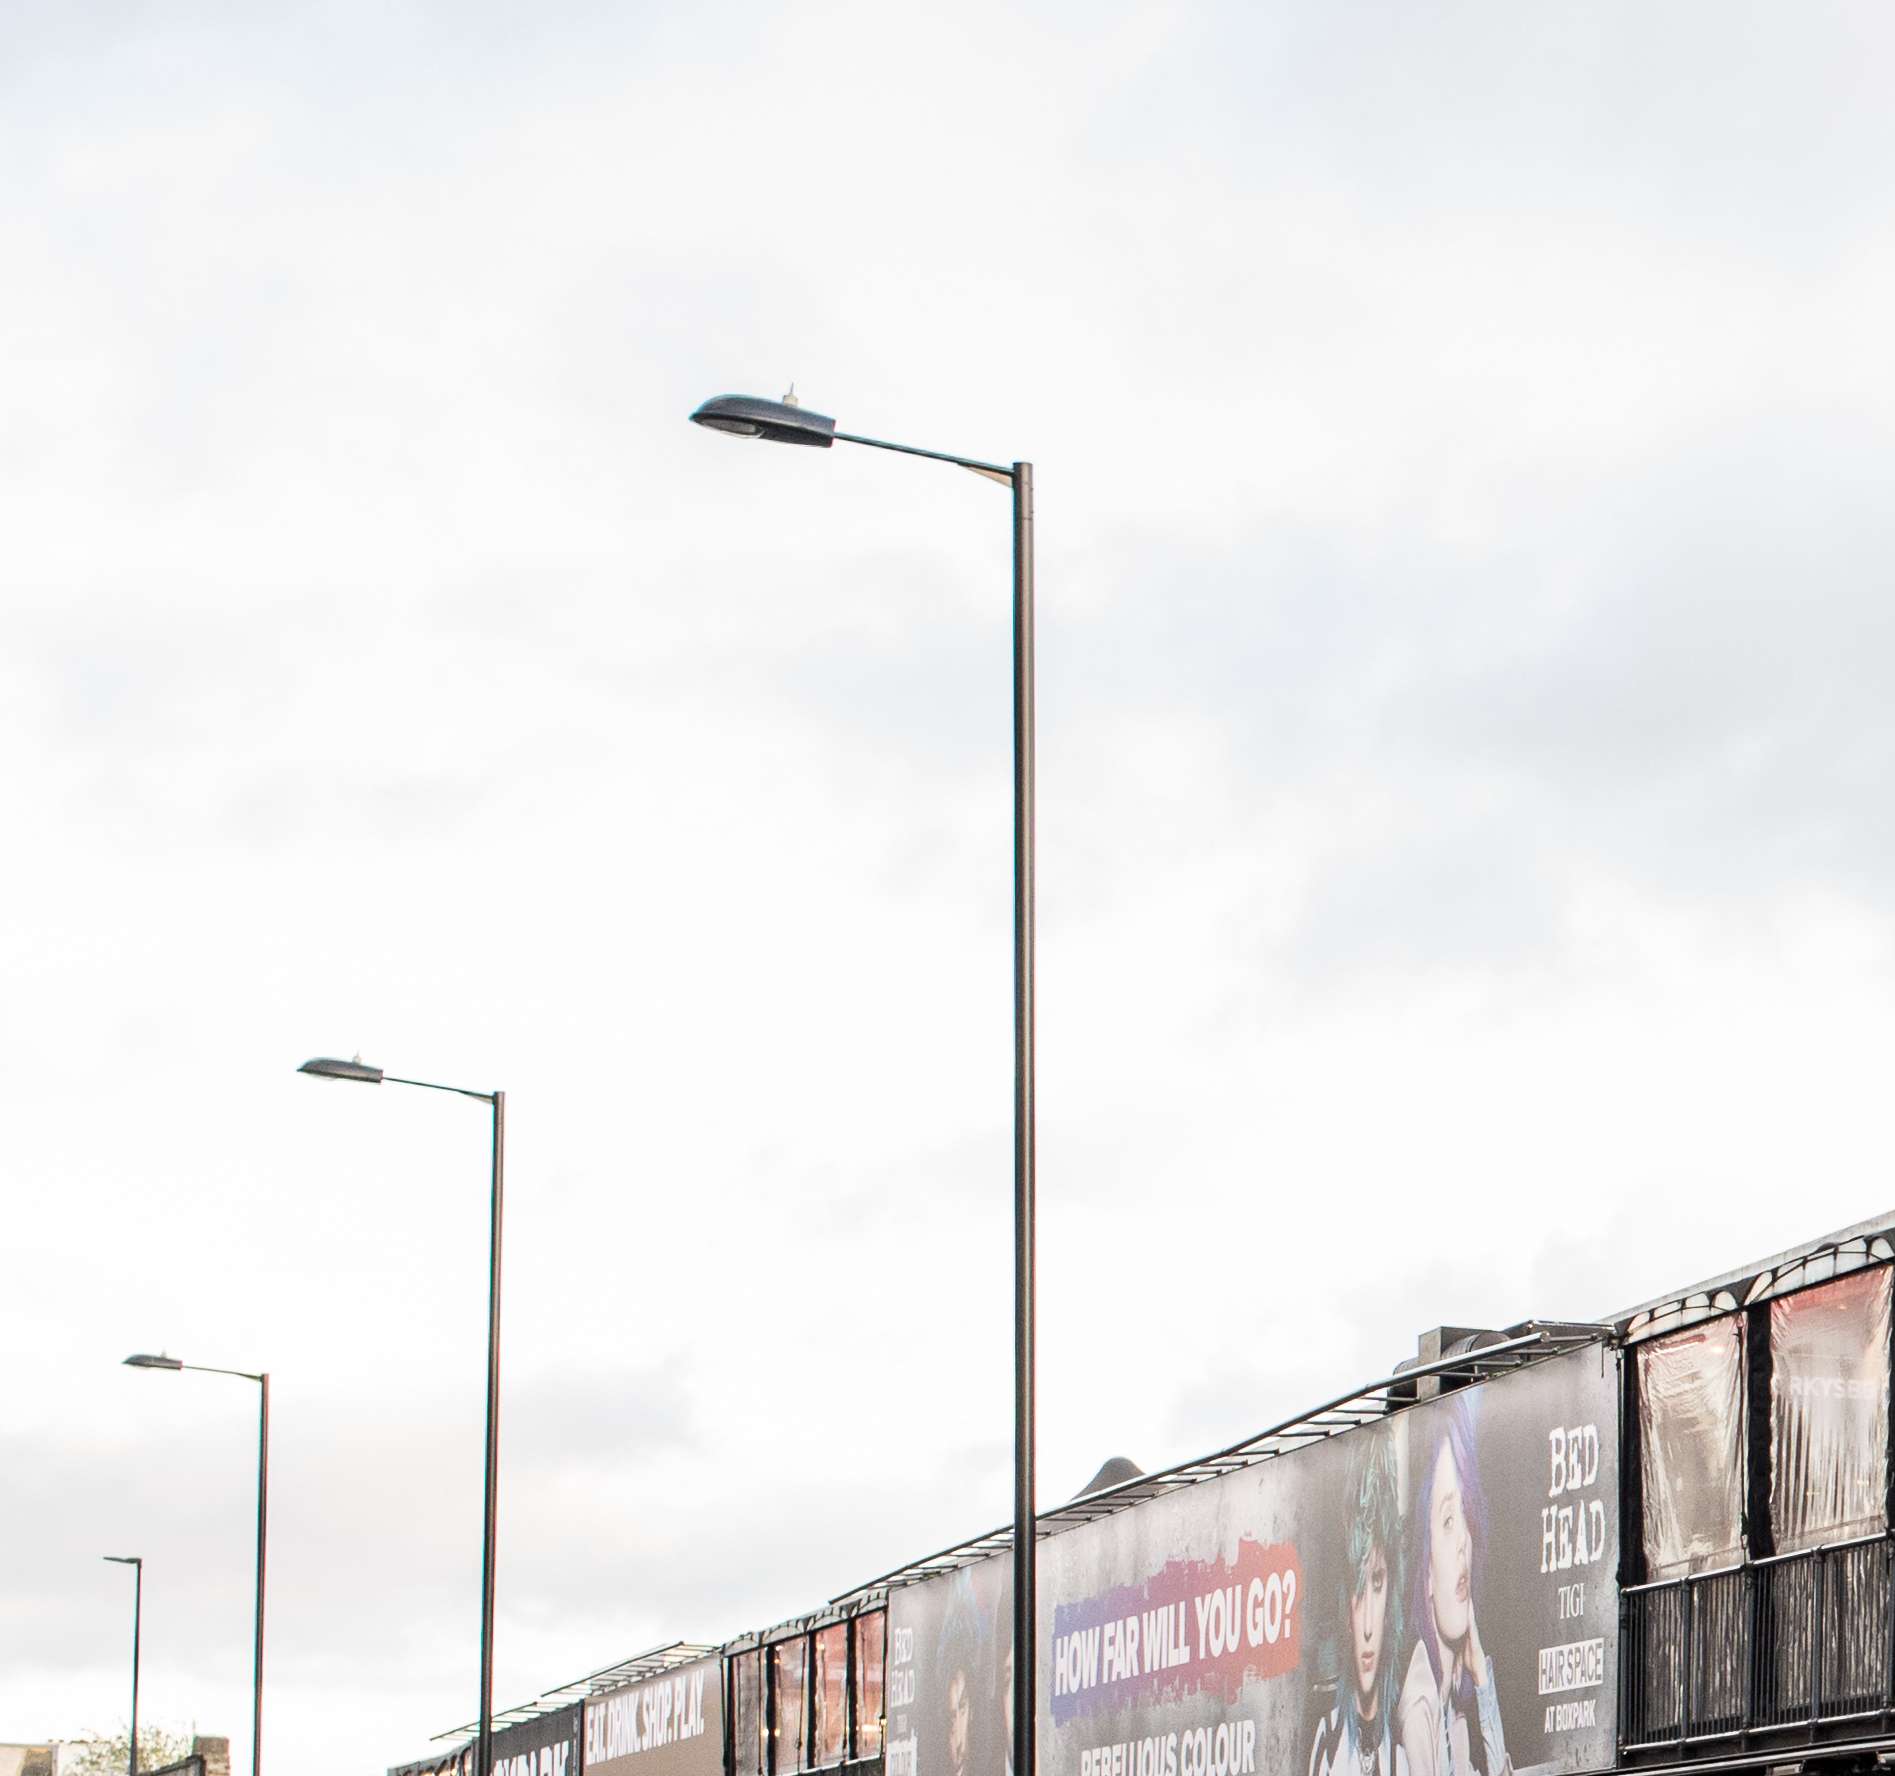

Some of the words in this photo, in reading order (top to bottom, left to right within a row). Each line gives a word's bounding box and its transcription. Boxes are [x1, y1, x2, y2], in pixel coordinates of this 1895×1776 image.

[1549, 1422, 1600, 1499] BED
[1540, 1499, 1605, 1574] HEAD
[1558, 1583, 1585, 1619] TIGI
[1055, 1626, 1100, 1697] HOW
[1102, 1615, 1139, 1684] FAR
[1142, 1601, 1190, 1674] WILL
[1195, 1584, 1243, 1659] YOU
[1246, 1569, 1296, 1648] GO?
[1540, 1647, 1565, 1691] HAIR
[1566, 1642, 1602, 1687] SPACE
[1545, 1705, 1555, 1733] AT
[1556, 1699, 1597, 1732] BOXPARK
